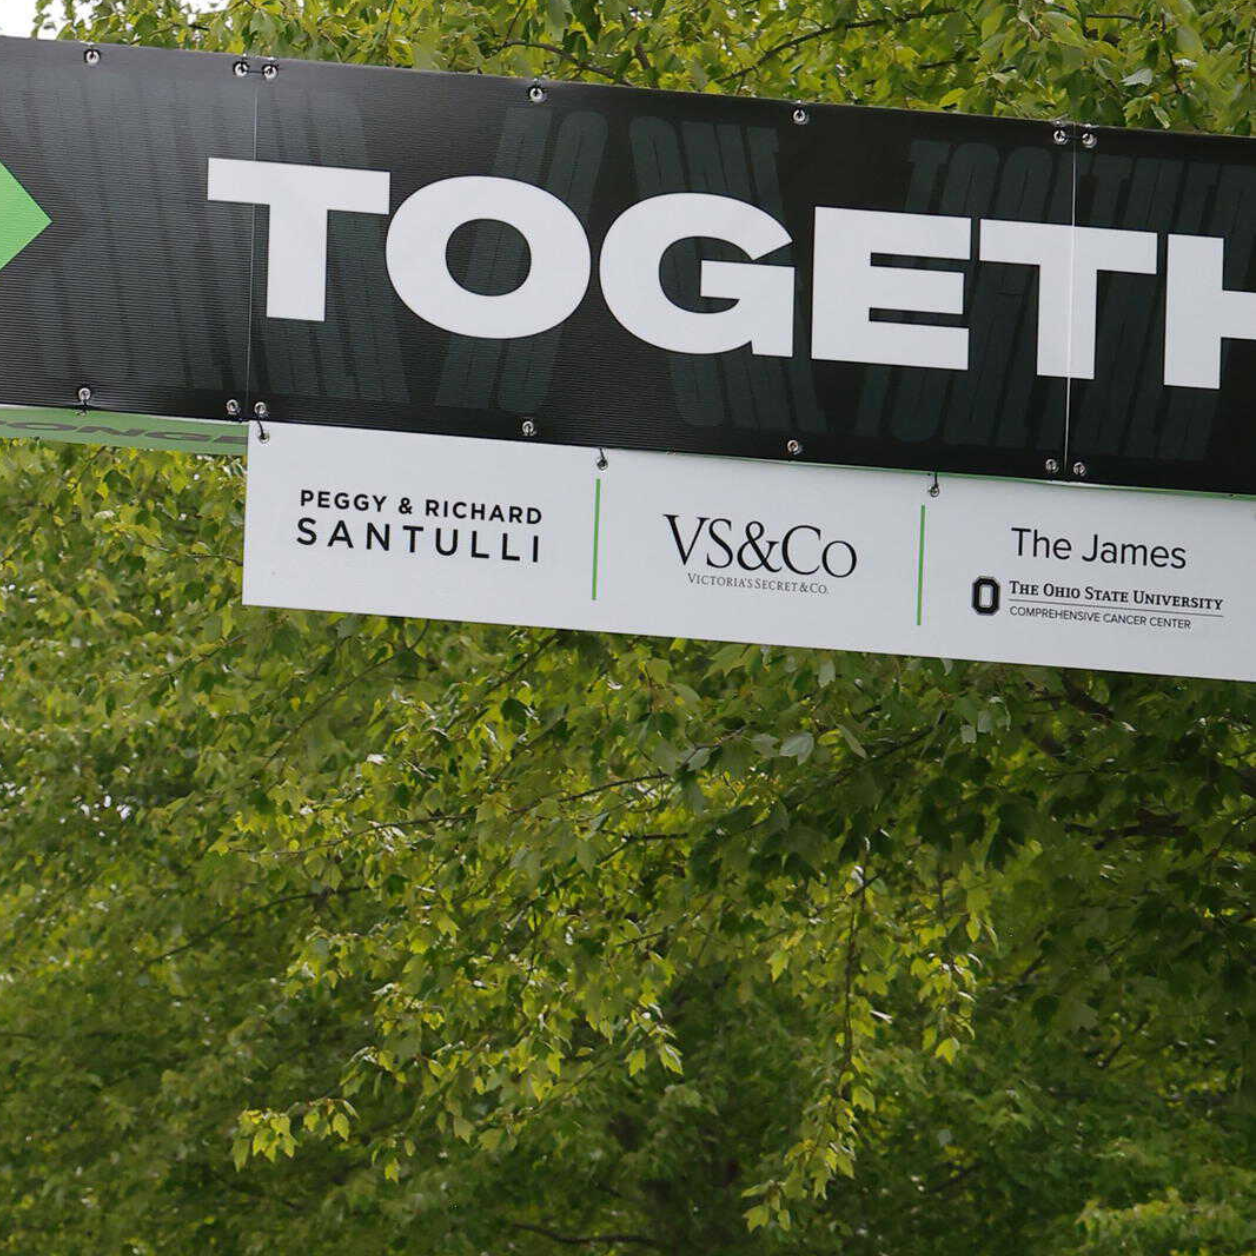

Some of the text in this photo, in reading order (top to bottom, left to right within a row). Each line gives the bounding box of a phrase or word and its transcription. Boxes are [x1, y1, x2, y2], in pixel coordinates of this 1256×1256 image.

[300, 489, 542, 525] PEGGY & RICHARD
[296, 517, 539, 563] SANTULLI
[1011, 527, 1187, 570] The James
[687, 572, 753, 589] VICTORIA'S
[1009, 580, 1223, 611] THE OHIO STATE UNIVERSITY
[1009, 605, 1192, 629] COMPREHENSIVE CANCER CENTER
